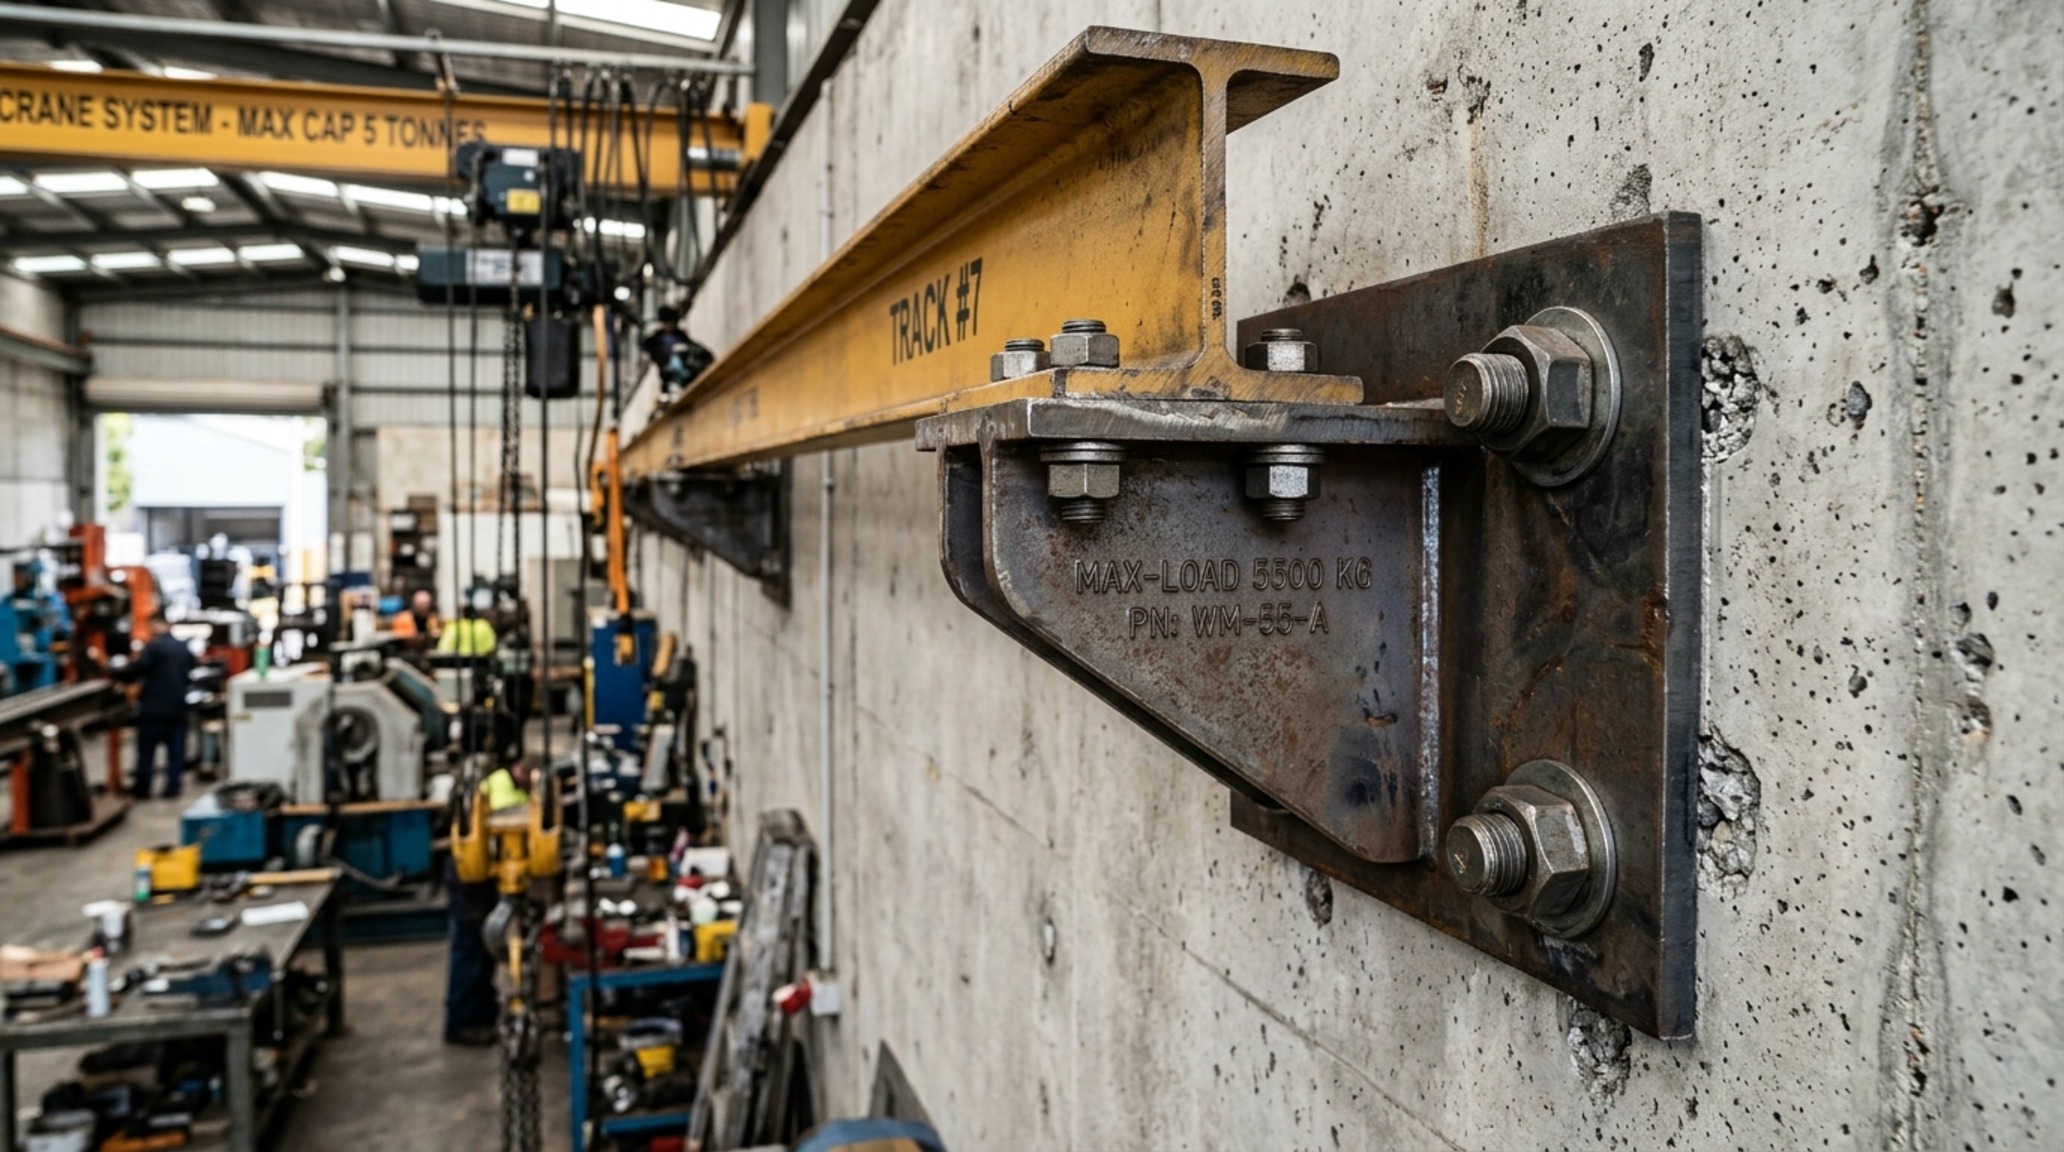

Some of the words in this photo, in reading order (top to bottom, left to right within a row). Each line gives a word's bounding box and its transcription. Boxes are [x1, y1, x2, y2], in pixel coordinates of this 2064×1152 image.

[0, 88, 93, 128] CRANE
[103, 95, 212, 134] SYSTEM
[237, 106, 293, 140] MAX
[303, 108, 354, 143] CAP
[364, 114, 377, 144] 5
[890, 273, 950, 365] TRACK
[956, 257, 983, 342] #7
[1075, 558, 1240, 595] MAX-LOAD
[1252, 557, 1324, 591] 5500
[1336, 556, 1372, 590] KG
[1128, 605, 1180, 640] PN:
[1192, 600, 1329, 638] WM-55-A
